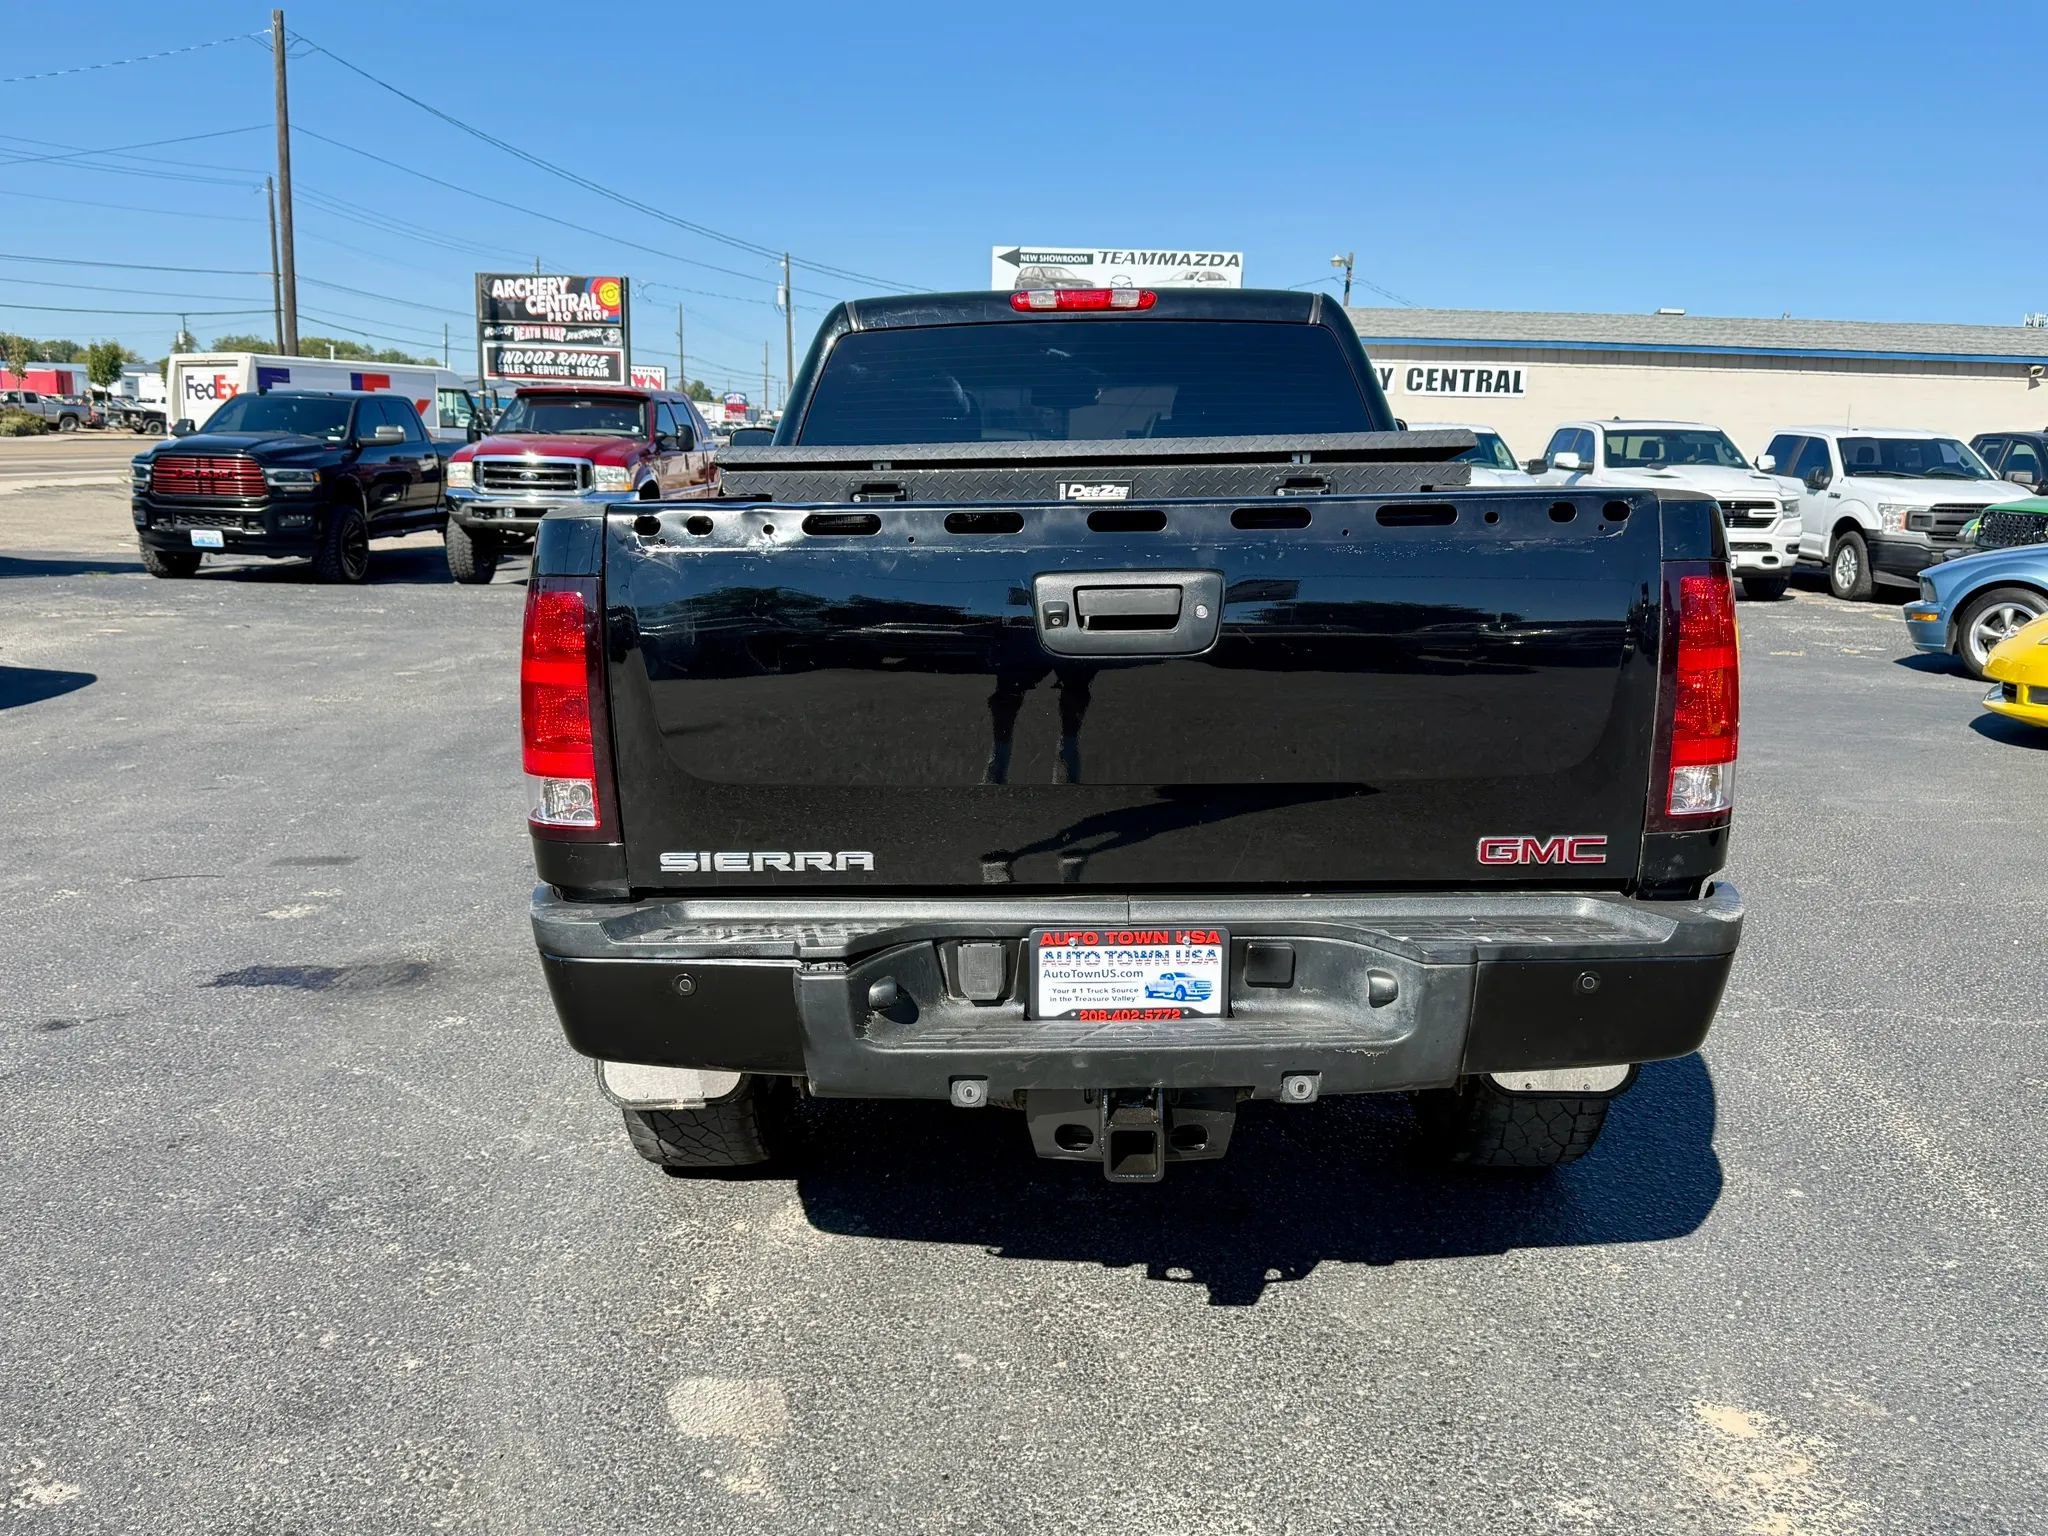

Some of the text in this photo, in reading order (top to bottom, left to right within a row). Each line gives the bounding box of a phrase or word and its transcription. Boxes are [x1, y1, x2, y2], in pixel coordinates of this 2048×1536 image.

[1020, 253, 1088, 264] NEW SHOWROOM
[491, 276, 570, 298] ARCHERY
[525, 293, 601, 315] CENTRAL
[547, 309, 609, 322] PRO SHOP
[514, 325, 541, 342] DEATH
[498, 350, 610, 368] INDOOR RANGE
[498, 364, 609, 377] SALES SERVICE REPAIR
[185, 374, 239, 400] FedEx
[1374, 367, 1523, 393] Y CENTRAL
[1478, 835, 1607, 865] GMC
[659, 851, 875, 872] SIERRA
[1040, 930, 1221, 946] AUTO TOWN USA
[1041, 948, 1219, 967] AUTO TOWN USA
[1043, 969, 1144, 979] AutoTownUS.com
[1079, 1009, 1181, 1021] 208-402-5772
